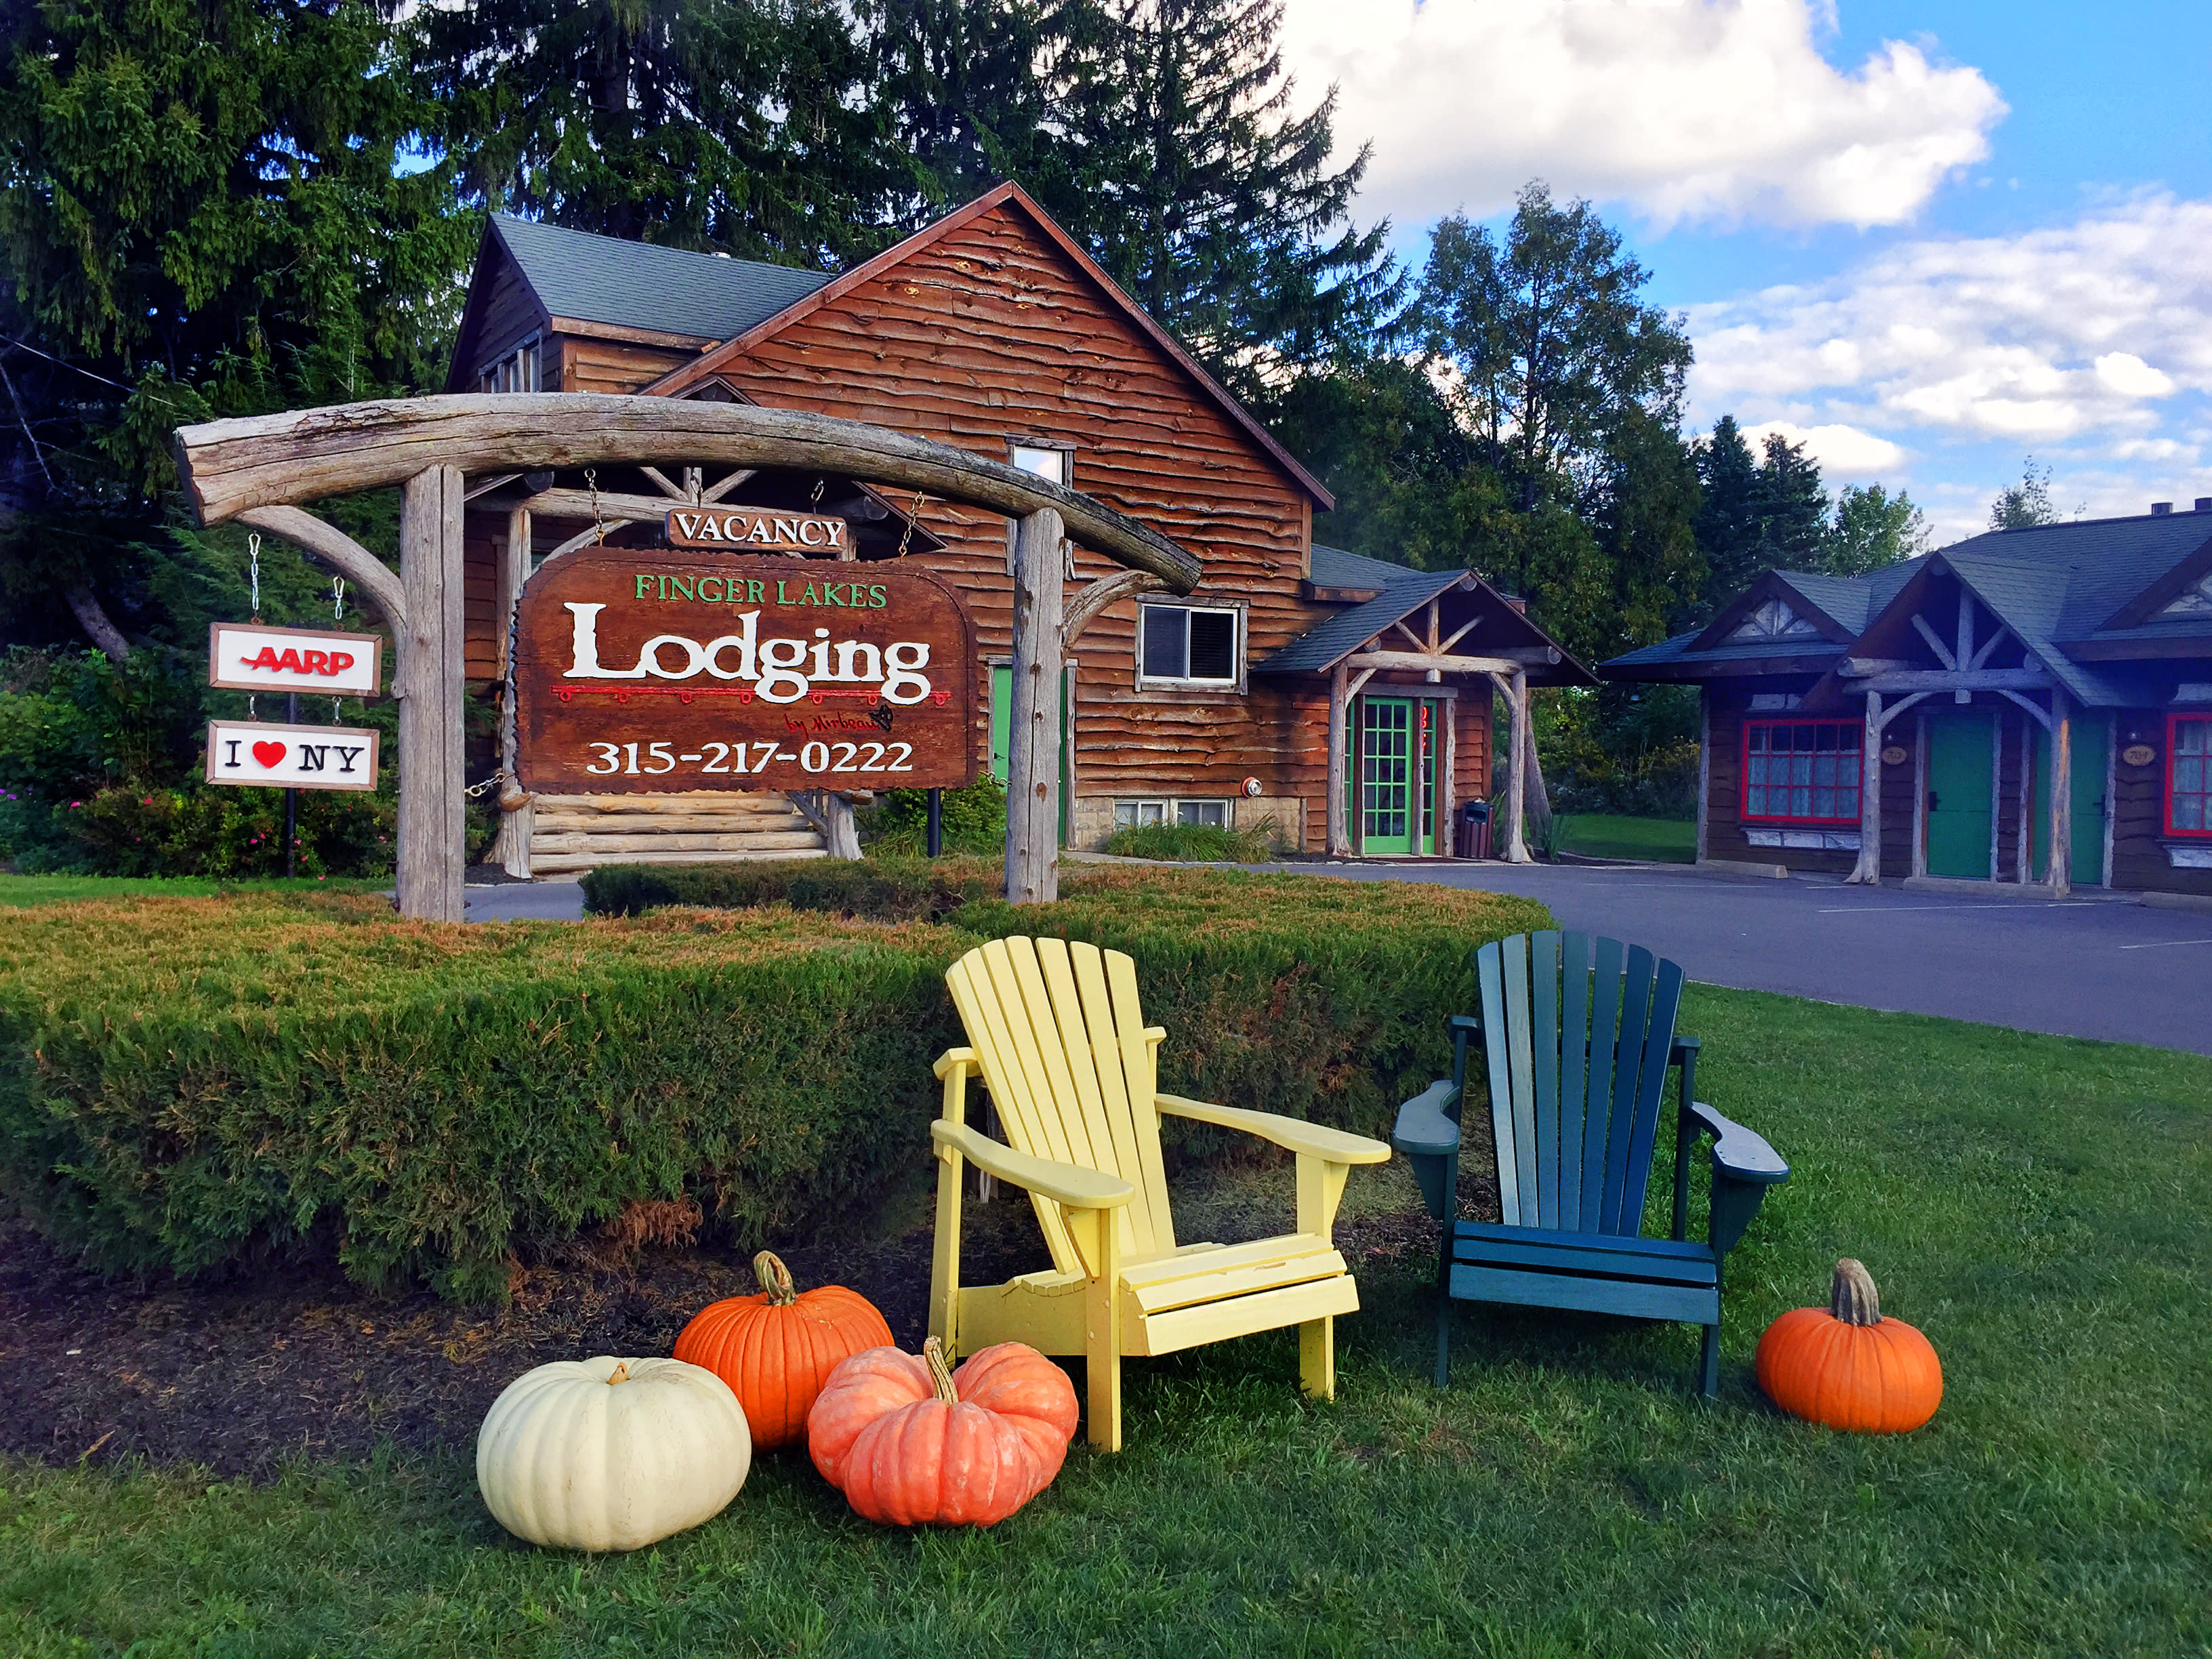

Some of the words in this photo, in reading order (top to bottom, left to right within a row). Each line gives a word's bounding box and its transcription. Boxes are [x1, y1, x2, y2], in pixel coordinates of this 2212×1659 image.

[674, 513, 846, 547] VACANCY
[634, 574, 766, 604] FINGER
[777, 580, 888, 609] LAKES
[239, 647, 354, 676] AARP
[562, 602, 931, 705] Lodging
[783, 713, 809, 739] by
[811, 712, 880, 732] Mirbeau
[224, 740, 242, 767] I
[298, 744, 365, 772] NY
[586, 741, 914, 775] 315-217-0222
